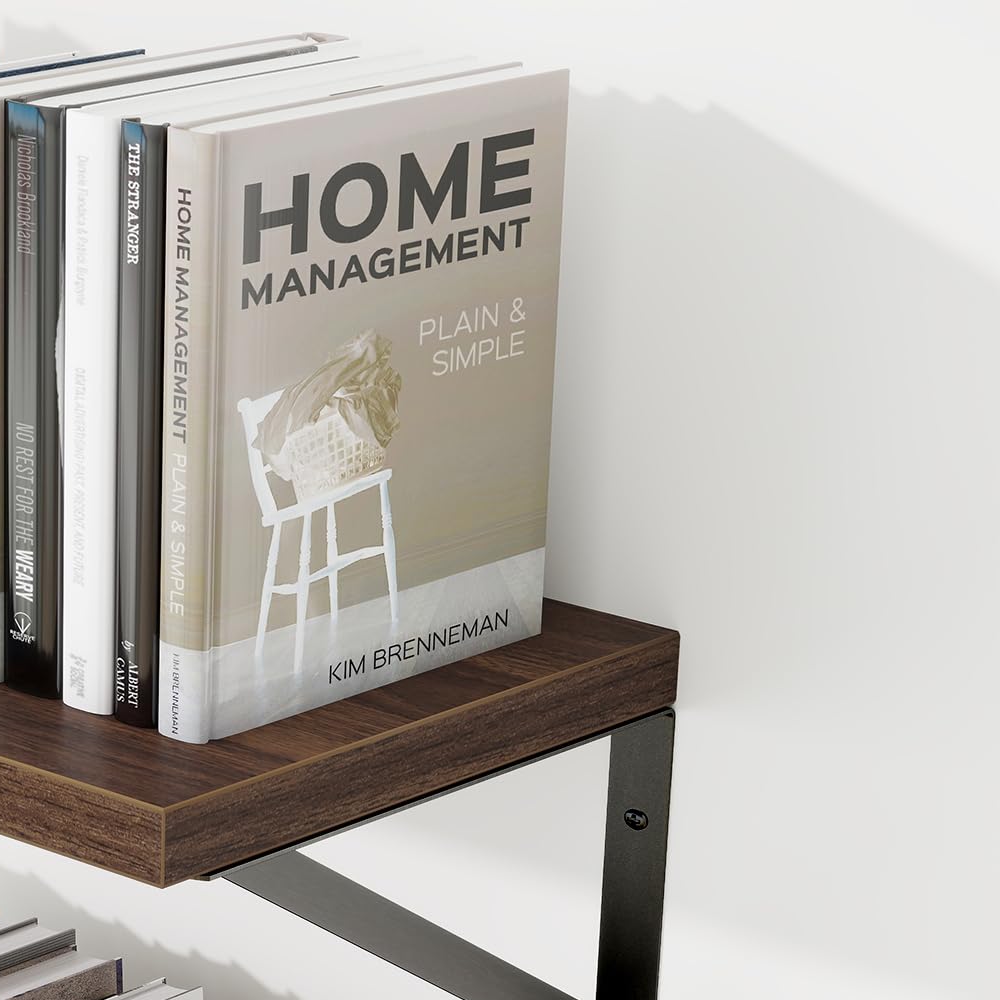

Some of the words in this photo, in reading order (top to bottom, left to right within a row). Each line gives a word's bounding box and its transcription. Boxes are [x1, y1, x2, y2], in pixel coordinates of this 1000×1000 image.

[17, 134, 37, 188] Nicholas
[128, 143, 141, 177] THE
[127, 181, 140, 264] STRANGER
[242, 128, 535, 265] HOME
[17, 192, 36, 255] Brookland
[176, 187, 192, 261] HOME
[241, 216, 531, 310] MANAGEMENT
[419, 302, 499, 345] PLAIN
[509, 297, 527, 323] &
[172, 266, 189, 444] MANAGEMENT
[432, 330, 525, 376] SIMPLE
[15, 422, 35, 443] NO
[15, 446, 35, 484] REST
[171, 454, 187, 515] PLAIN
[15, 486, 35, 514] FOR
[172, 520, 185, 533] &
[15, 519, 35, 547] THE
[15, 549, 35, 602] WEARY
[169, 541, 185, 617] SIMPLE
[121, 639, 134, 652] by
[328, 655, 366, 684] KIM
[373, 609, 509, 670] BRENNEMAN
[116, 657, 126, 703] CAMUS
[128, 661, 139, 708] ALBERT
[171, 671, 180, 735] BRENNEMAN
